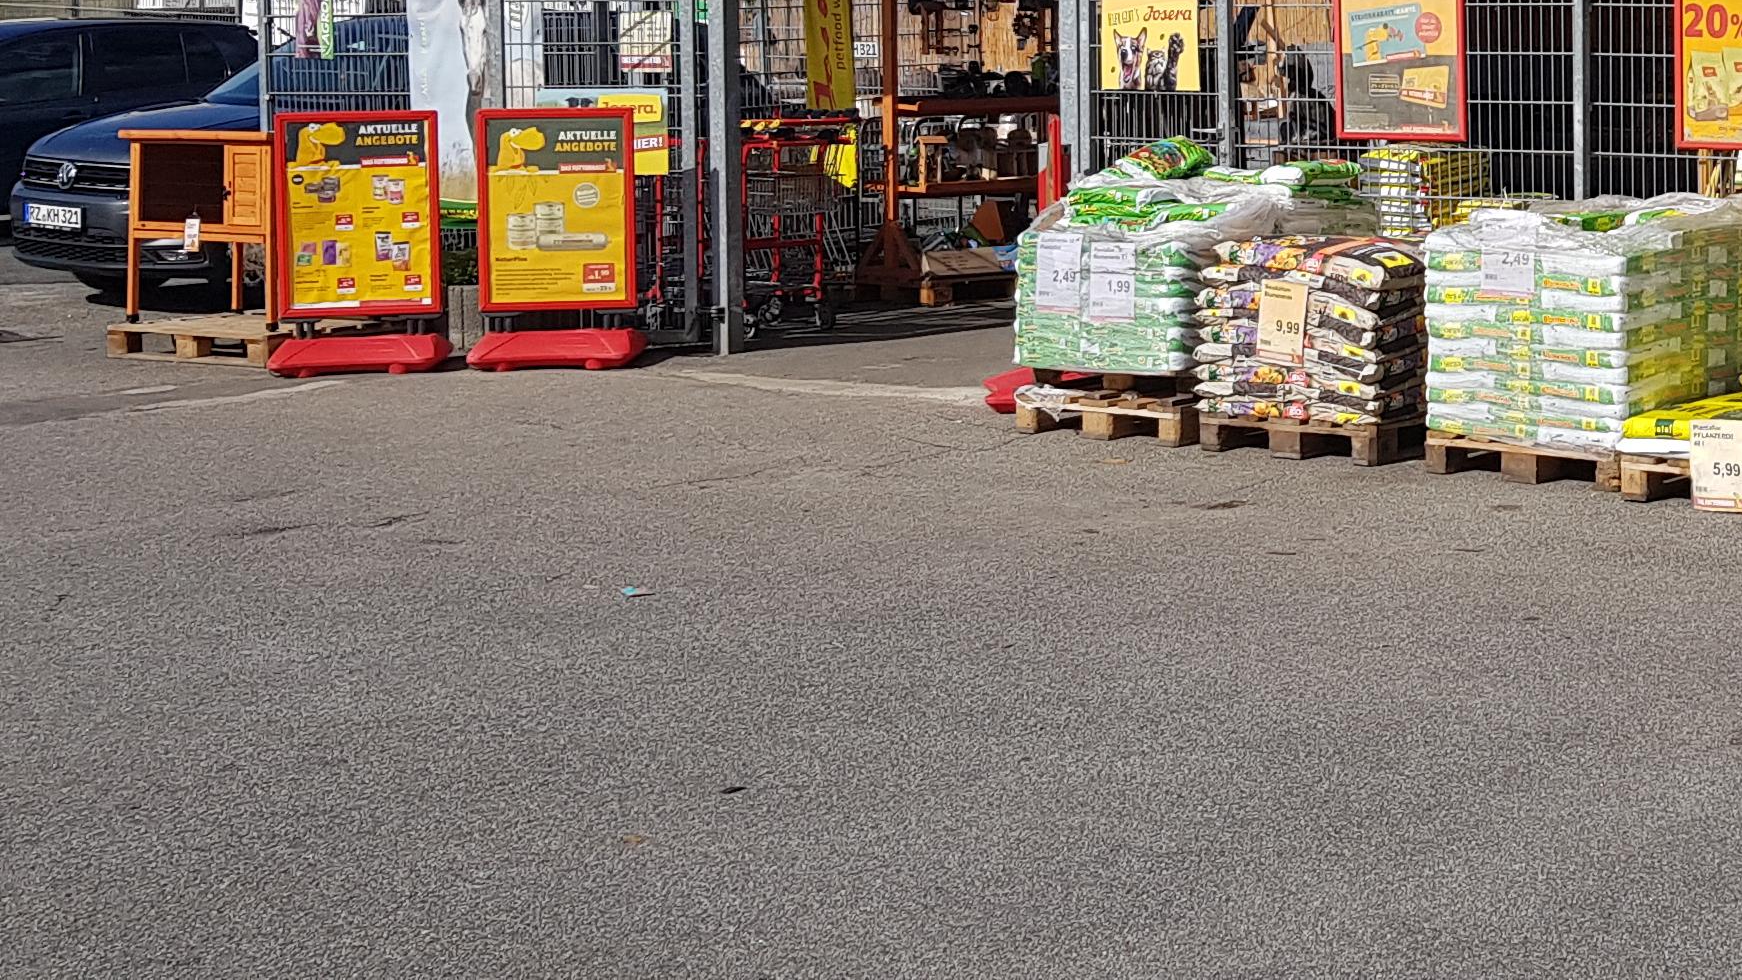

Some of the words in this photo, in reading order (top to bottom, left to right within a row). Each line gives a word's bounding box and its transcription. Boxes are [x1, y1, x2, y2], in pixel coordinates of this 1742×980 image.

[1143, 5, 1192, 21] Josera
[832, 12, 847, 70] petfood
[358, 123, 418, 134] AKTUELLE
[558, 130, 617, 140] AKTUELLE
[355, 135, 418, 146] ANGEBOTE
[554, 141, 617, 152] ANGEBOTE
[1501, 252, 1530, 267] 2,49
[1053, 270, 1076, 284] 2,49
[1107, 279, 1131, 294] 1,99
[1275, 319, 1300, 335] 9,99
[1712, 462, 1741, 479] 5,99
